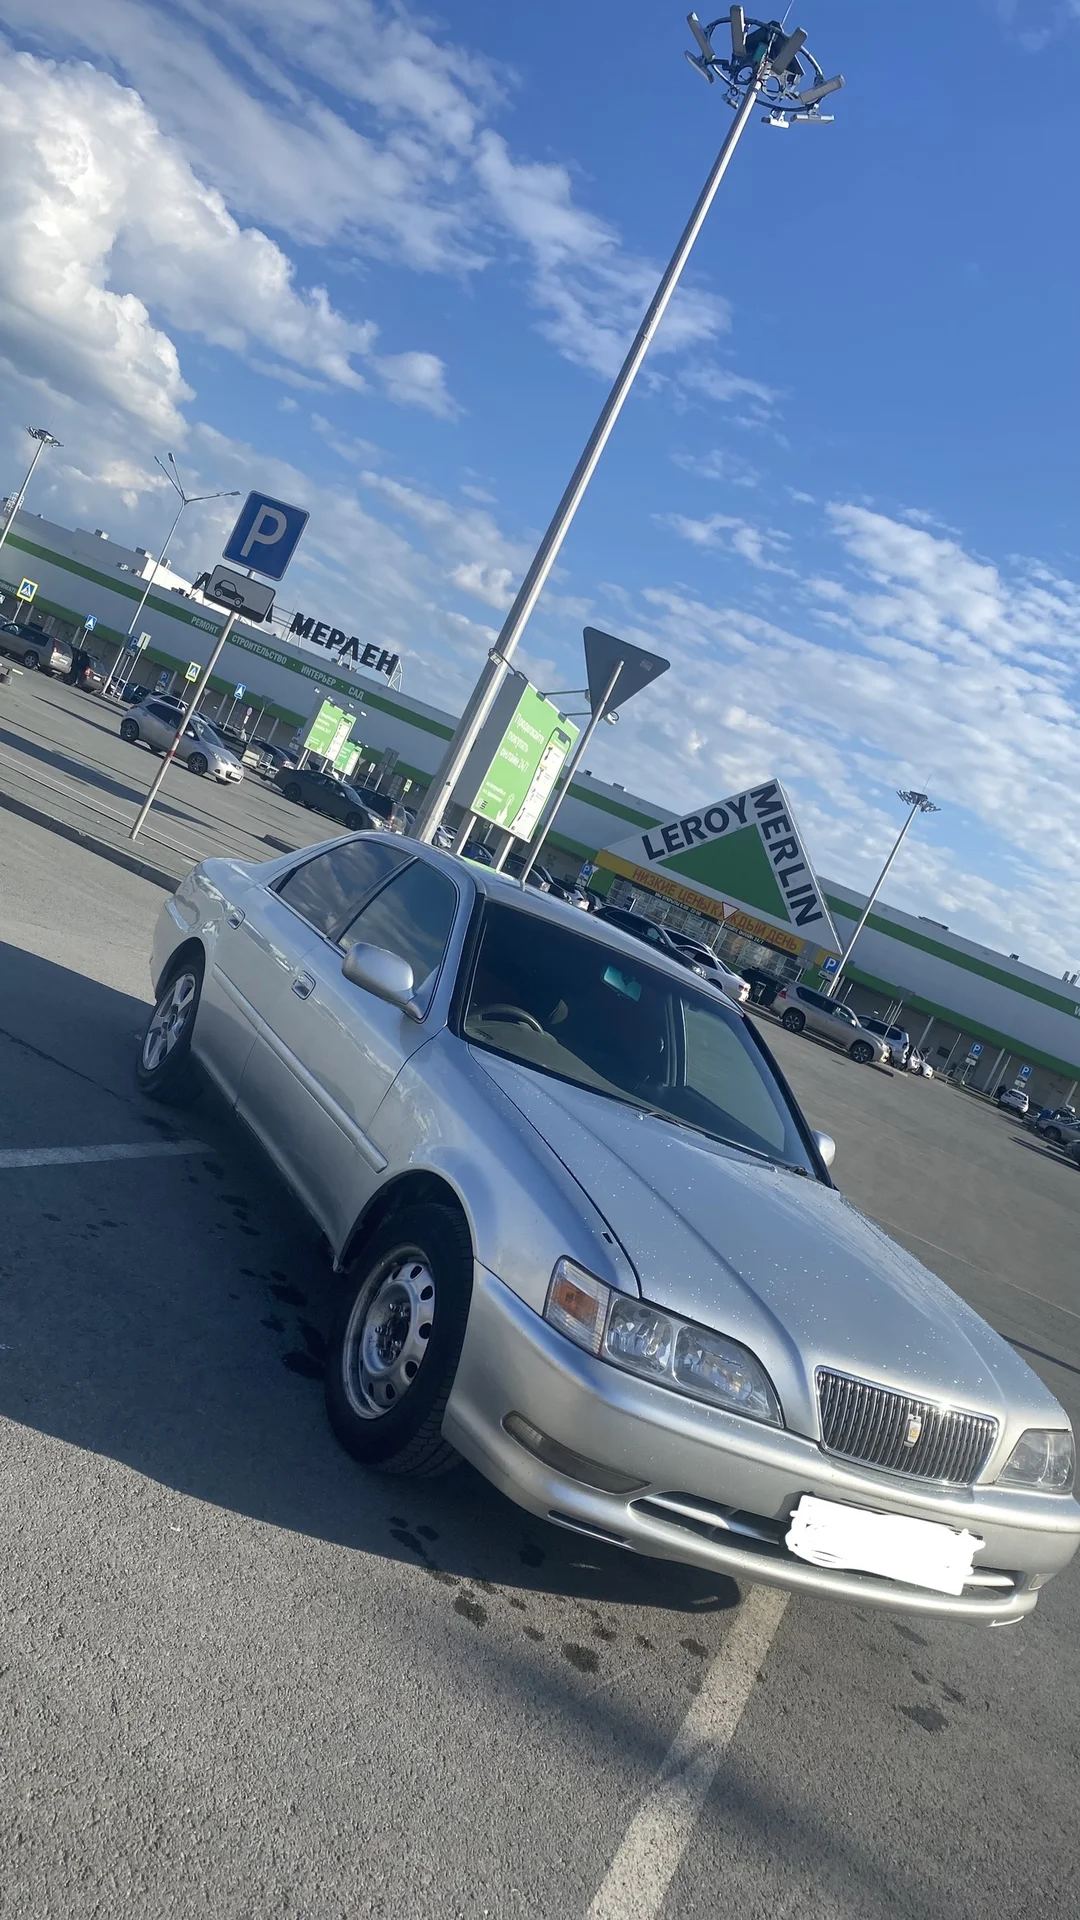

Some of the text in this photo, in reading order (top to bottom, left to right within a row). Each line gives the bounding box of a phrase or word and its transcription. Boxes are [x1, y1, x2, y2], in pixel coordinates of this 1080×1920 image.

[240, 503, 288, 558] P
[191, 616, 365, 700] РЕМОНТ СТРОИТЕЛЬСТВО ИНТЕРЬЕР САД
[289, 612, 399, 676] МЕРЛЕН
[641, 795, 748, 860] LEROY
[750, 783, 823, 927] MERLIN
[633, 868, 678, 894] НИЗКИЕ
[678, 889, 711, 911] ЦЕНЫ
[765, 927, 797, 951] ДЕНЬ
[826, 957, 837, 969] P
